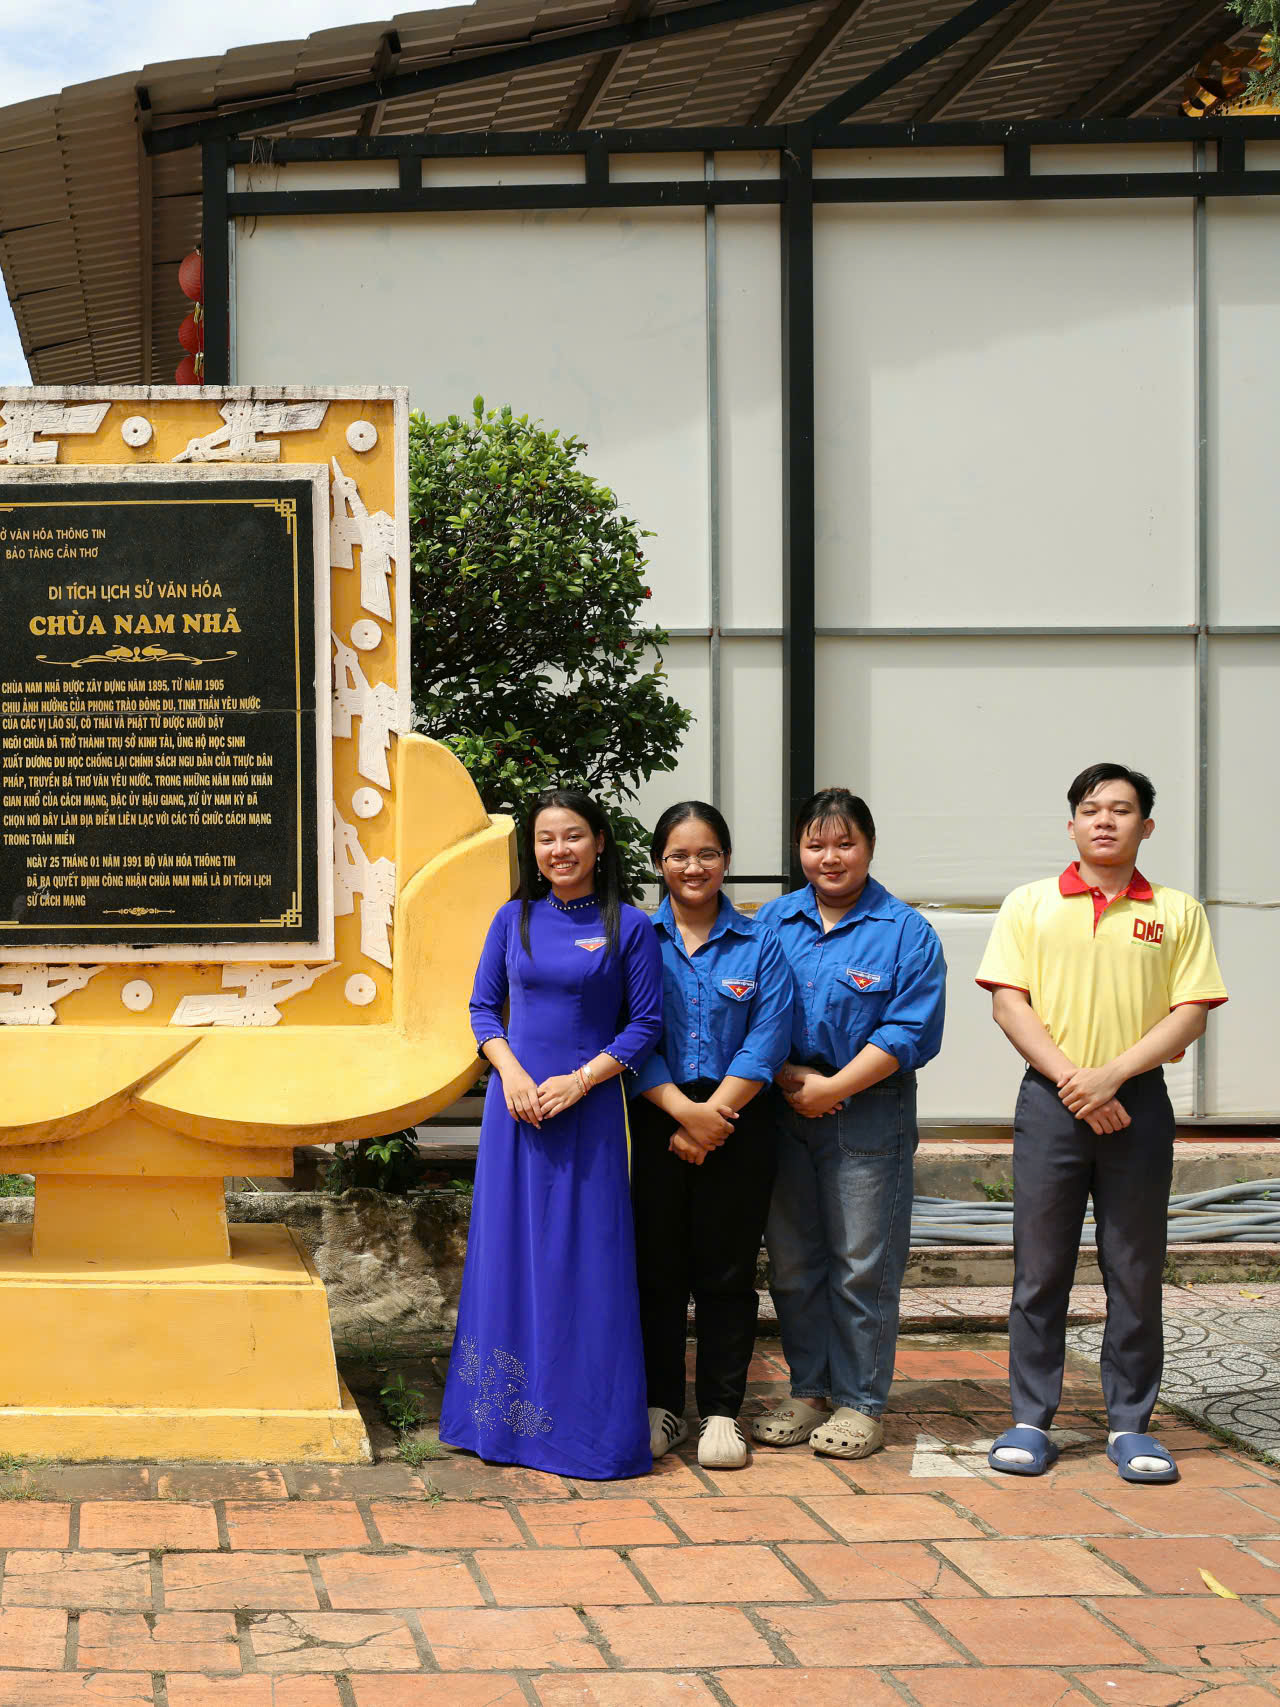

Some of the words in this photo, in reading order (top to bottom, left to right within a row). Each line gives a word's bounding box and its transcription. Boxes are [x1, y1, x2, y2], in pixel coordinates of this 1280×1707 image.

[10, 527, 30, 541] VĂN
[33, 527, 53, 540] HÓA
[56, 527, 89, 540] THÔNG
[92, 529, 106, 540] TIN
[6, 547, 26, 560] BẢO
[29, 546, 54, 559] TÀNG
[57, 544, 77, 559] CẦN
[80, 547, 99, 559] THƠ
[49, 586, 63, 601] DI
[66, 582, 97, 600] TÍCH
[101, 586, 130, 603] LỊCH
[135, 580, 153, 600] SỬ
[158, 581, 187, 599] VĂN
[192, 581, 222, 599] HÓA
[30, 609, 107, 635] CHÙA
[114, 615, 176, 634] NAM
[183, 607, 242, 633] NHÃ
[2, 678, 23, 693] CHÙA
[25, 681, 43, 693] NAM
[45, 678, 61, 692] NHÃ
[63, 679, 85, 694] ĐƯỢC
[87, 677, 102, 692] XÂY
[104, 679, 126, 694] DỰNG
[128, 677, 146, 691] NĂM
[171, 676, 183, 691] TỪ
[185, 676, 203, 691] NĂM
[205, 679, 225, 691] 1905
[23, 699, 39, 712] ẢNH
[41, 698, 69, 711] HƯỞNG
[70, 698, 86, 711] CỦA
[88, 701, 114, 711] PHONG
[116, 698, 137, 711] TRÀO
[139, 698, 161, 711] ĐÔNG
[178, 700, 197, 710] TINH
[198, 695, 220, 710] THẦN
[222, 697, 238, 710] YÊU
[240, 696, 261, 710] NƯỚC
[3, 715, 19, 730] CỦA
[21, 715, 36, 730] CÁC
[39, 718, 46, 732] VỊ
[48, 715, 64, 729] LÃO
[94, 715, 113, 729] THÁI
[115, 715, 125, 729] VÀ
[127, 714, 147, 731] PHẬT
[150, 714, 161, 729] TỬ
[163, 715, 185, 731] ĐƯỢC
[3, 734, 22, 749] NGÔI
[24, 734, 45, 749] CHÙA
[47, 734, 58, 748] ĐÃ
[60, 733, 77, 748] TRỞ
[78, 734, 105, 748] THÀNH
[107, 737, 123, 750] TRỤ
[125, 733, 136, 748] SỞ
[138, 736, 158, 748] KINH
[177, 733, 194, 747] ỦNG
[195, 733, 207, 749] HỘ
[209, 736, 225, 749] HỌC
[227, 736, 246, 747] SINH
[2, 751, 24, 769] XUẤT
[26, 754, 53, 769] DƯƠNG
[54, 756, 66, 768] DU
[68, 756, 84, 771] HỌC
[86, 750, 113, 768] CHỐNG
[115, 756, 128, 770] LẠI
[130, 752, 154, 768] CHÍNH
[156, 752, 177, 768] SÁCH
[179, 755, 195, 767] NGU
[197, 752, 213, 767] DÂN
[216, 751, 231, 767] CỦA
[233, 753, 255, 769] THỰC
[257, 751, 273, 767] DÂN
[28, 771, 61, 788] TRUYỀN
[62, 773, 73, 787] BÁ
[74, 774, 92, 787] THƠ
[93, 773, 110, 787] VĂN
[112, 773, 128, 787] YÊU
[129, 772, 153, 787] NƯỚC.
[154, 775, 182, 787] TRONG
[212, 772, 231, 786] NĂM
[232, 772, 249, 786] KHÓ
[251, 771, 273, 786] KHĂN
[3, 795, 22, 807] GIAN
[24, 790, 41, 807] KHỔ
[43, 792, 59, 806] CỦA
[61, 792, 82, 806] CÁCH
[111, 792, 127, 808] ĐẶC
[129, 791, 140, 806] ỦY
[142, 791, 159, 808] HẬU
[189, 790, 199, 805] XỨ
[202, 791, 212, 805] ỦY
[215, 794, 232, 805] NAM
[234, 791, 245, 805] KỲ
[247, 790, 258, 805] ĐÃ
[3, 814, 26, 828] CHỌN
[27, 813, 41, 826] NƠI
[43, 811, 59, 826] ĐÂY
[61, 811, 78, 825] LÀM
[80, 814, 94, 827] ĐỊA
[96, 808, 116, 825] ĐIỂM
[118, 810, 137, 825] LIÊN
[139, 813, 154, 827] LẠC
[156, 809, 170, 825] VỚI
[171, 810, 188, 824] CÁC
[189, 808, 200, 824] TỔ
[202, 809, 224, 824] CHỨC
[226, 810, 247, 824] CÁCH
[249, 812, 272, 826] MẠNG
[3, 834, 30, 846] TRONG
[31, 831, 53, 846] TOÀN
[55, 829, 76, 845] MIỀN
[27, 853, 48, 868] NGÀY
[50, 856, 60, 868] 25
[62, 853, 89, 867] THÁNG
[90, 856, 100, 867] 01
[103, 853, 121, 867] NĂM
[123, 856, 142, 867] 1991
[144, 852, 156, 869] BỘ
[158, 852, 174, 867] VĂN
[176, 852, 192, 867] HÓA
[194, 852, 222, 866] THÔNG
[223, 855, 236, 866] TIN
[27, 872, 38, 887] ĐÃ
[40, 875, 51, 887] RA
[53, 870, 78, 889] QUYẾT
[81, 875, 100, 888] ĐỊNH
[102, 872, 124, 886] CÔNG
[125, 872, 147, 888] NHẬN
[149, 871, 171, 886] CHÙA
[173, 874, 190, 886] NAM
[192, 871, 209, 885] NHÃ
[211, 871, 221, 885] LÀ
[223, 874, 232, 885] DI
[233, 871, 252, 885] TÍCH
[254, 874, 272, 887] LỊCH
[63, 894, 87, 908] MẠNG
